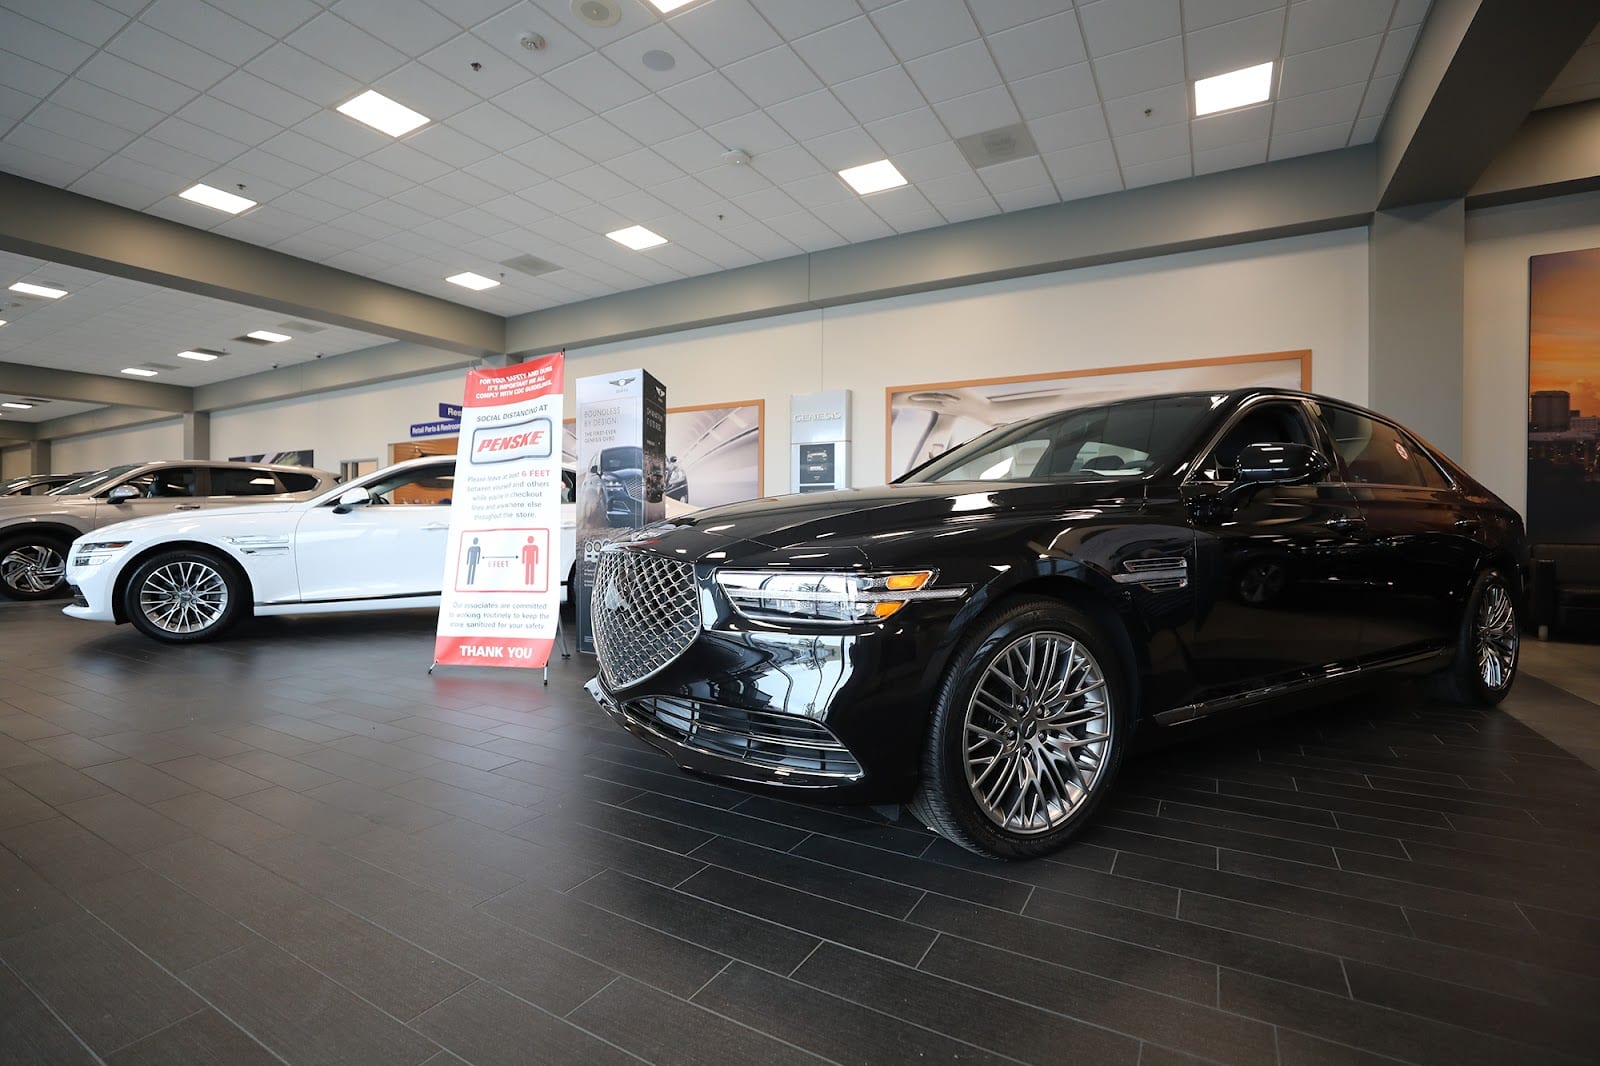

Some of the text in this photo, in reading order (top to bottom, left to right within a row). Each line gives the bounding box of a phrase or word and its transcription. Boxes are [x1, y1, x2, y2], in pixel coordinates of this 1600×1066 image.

[492, 377, 507, 385] YOUR
[506, 373, 528, 383] SAFETY
[528, 370, 539, 378] AND
[499, 379, 529, 391] IMPORTANT
[475, 391, 499, 399] COMPLY
[500, 389, 514, 397] WITH
[514, 387, 525, 395] CDC
[476, 404, 548, 423] SOCIAL DISTANCING AT
[584, 406, 621, 418] BOUNDLESS
[794, 411, 842, 423] GENESIS
[593, 418, 617, 427] DESIGN
[425, 425, 437, 433] Parts
[477, 430, 545, 453] PENSKE
[467, 475, 486, 483] Please
[529, 469, 551, 477] FEET
[467, 484, 491, 492] between
[512, 480, 525, 488] and
[526, 479, 550, 487] others
[510, 490, 543, 498] checkout
[527, 500, 542, 508] else
[492, 560, 509, 568] FEET
[464, 601, 498, 610] associates
[512, 602, 547, 610] committed
[456, 612, 481, 620] working
[483, 612, 512, 620] routinely
[459, 645, 533, 659] THANK YOU
